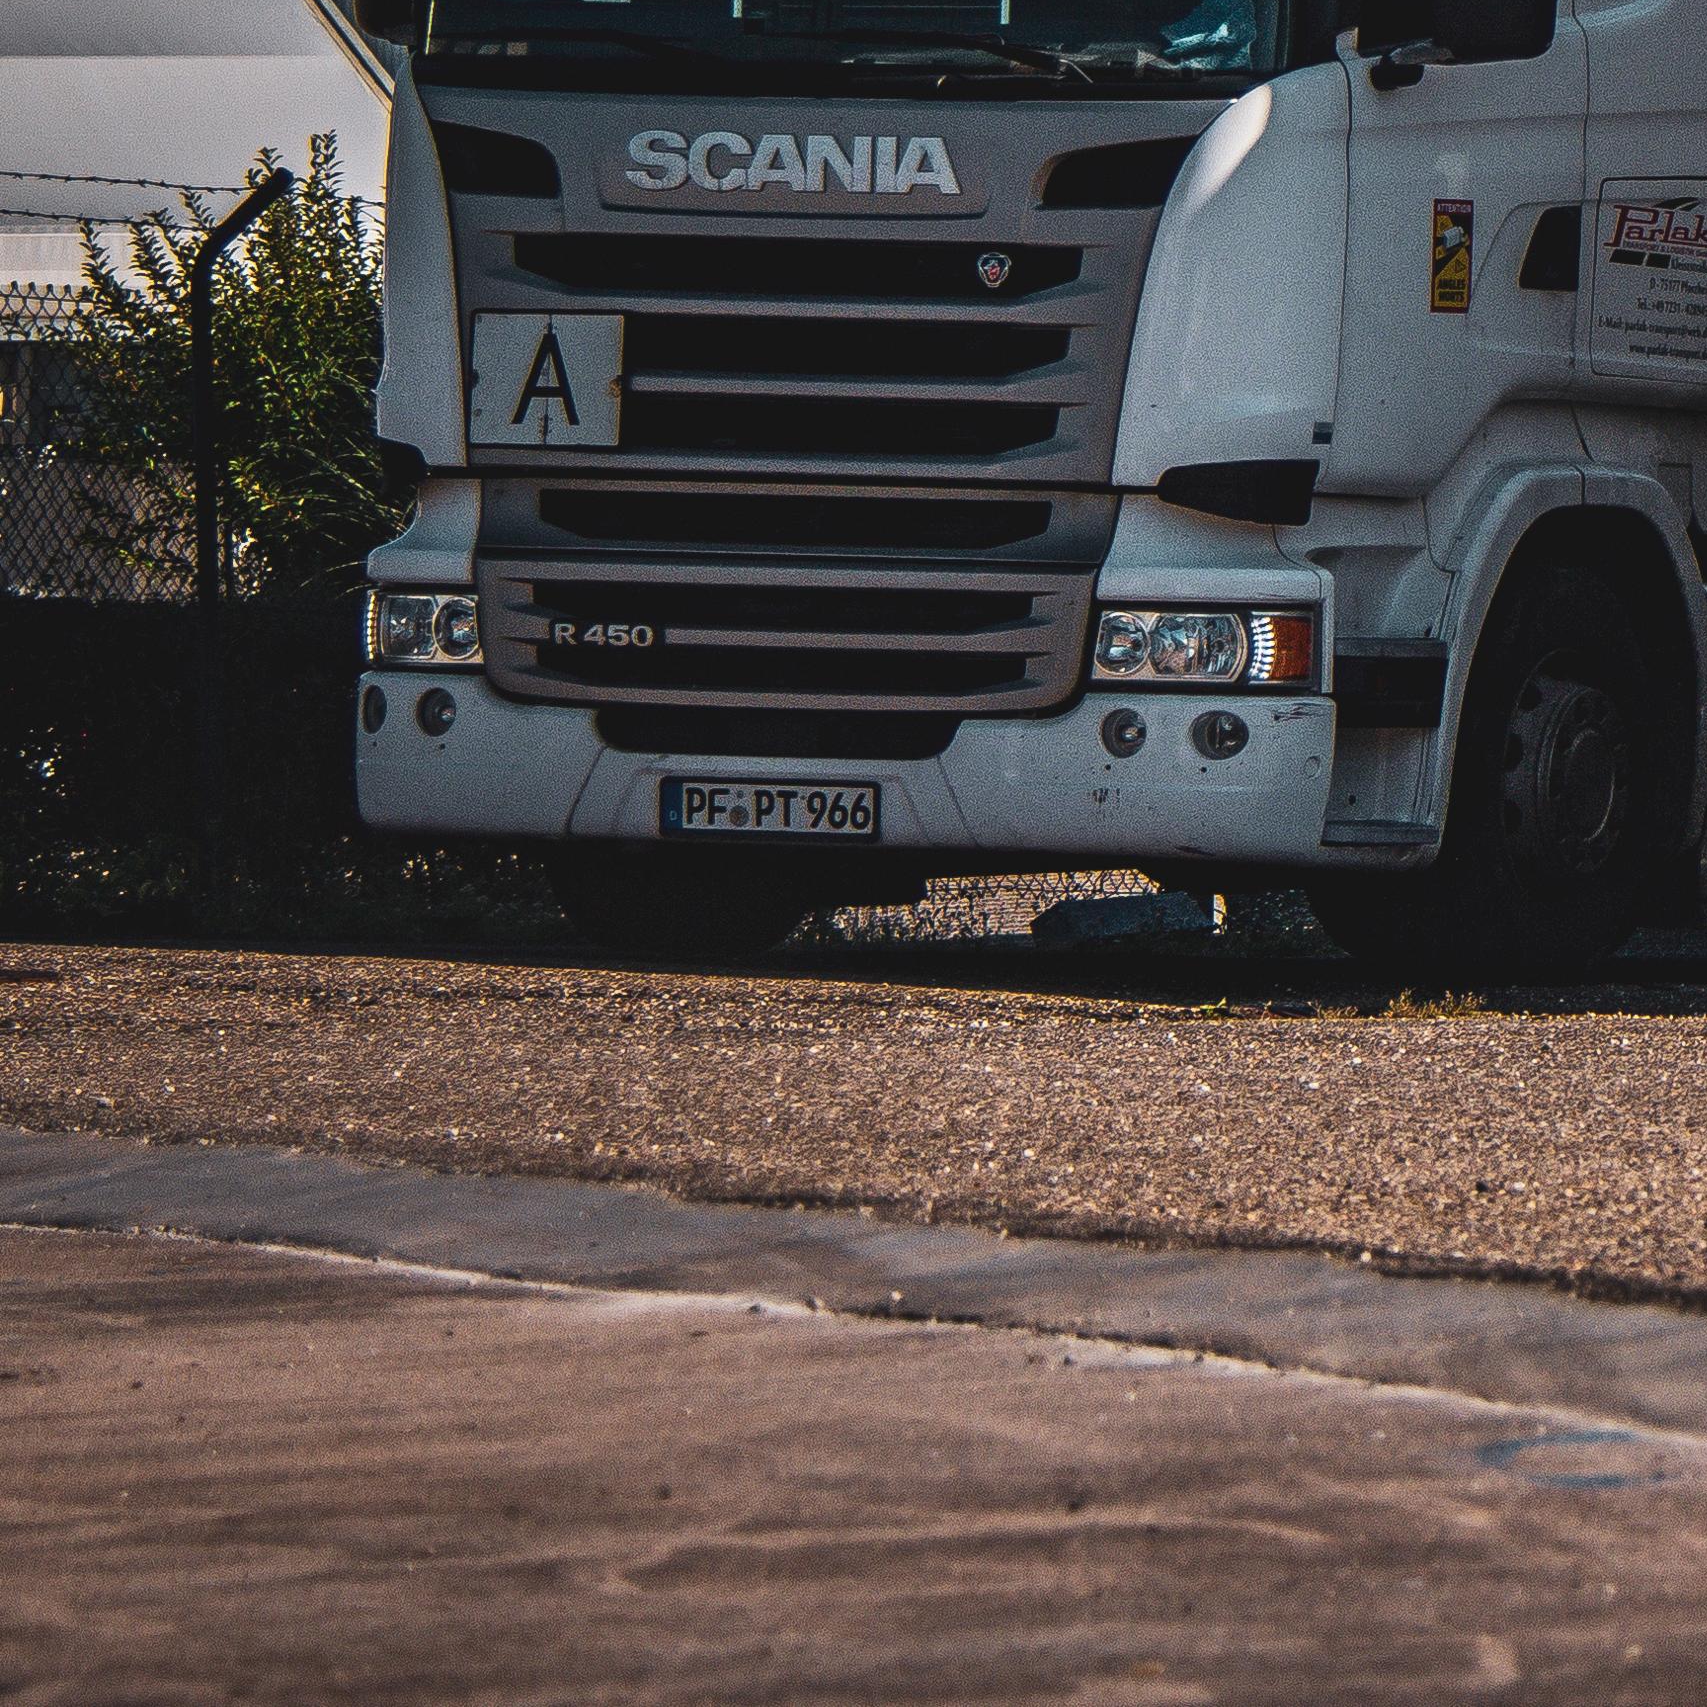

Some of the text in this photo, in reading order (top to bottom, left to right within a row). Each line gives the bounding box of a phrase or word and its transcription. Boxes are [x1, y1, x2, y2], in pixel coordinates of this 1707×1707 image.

[625, 130, 961, 194] SCANIA
[511, 332, 580, 426] A
[584, 624, 654, 647] 450
[685, 786, 872, 830] PF PT 966
